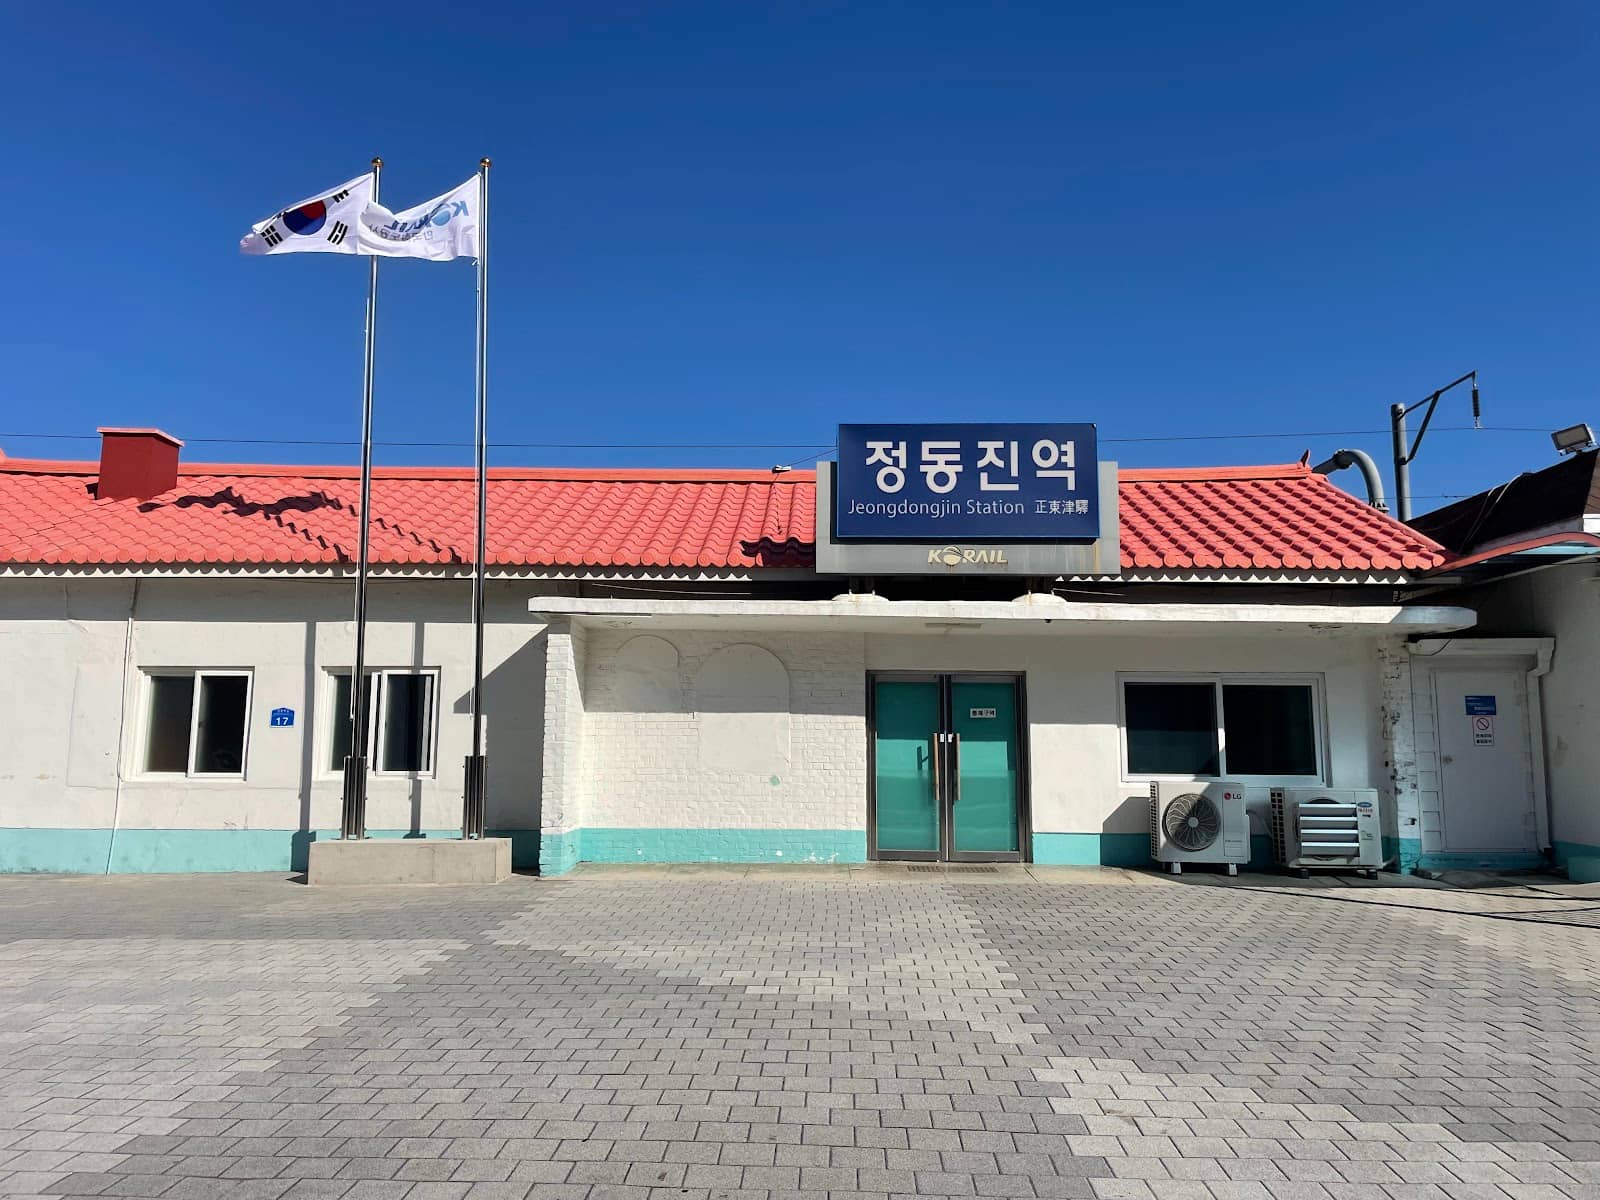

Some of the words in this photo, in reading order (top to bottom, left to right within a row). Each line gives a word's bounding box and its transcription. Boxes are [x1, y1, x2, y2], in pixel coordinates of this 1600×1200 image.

[865, 438, 1076, 494] 정동진역
[848, 499, 961, 519] Jeongdongjin
[966, 499, 1025, 515] Station
[927, 545, 1009, 567] KORAIL
[276, 716, 288, 726] 17
